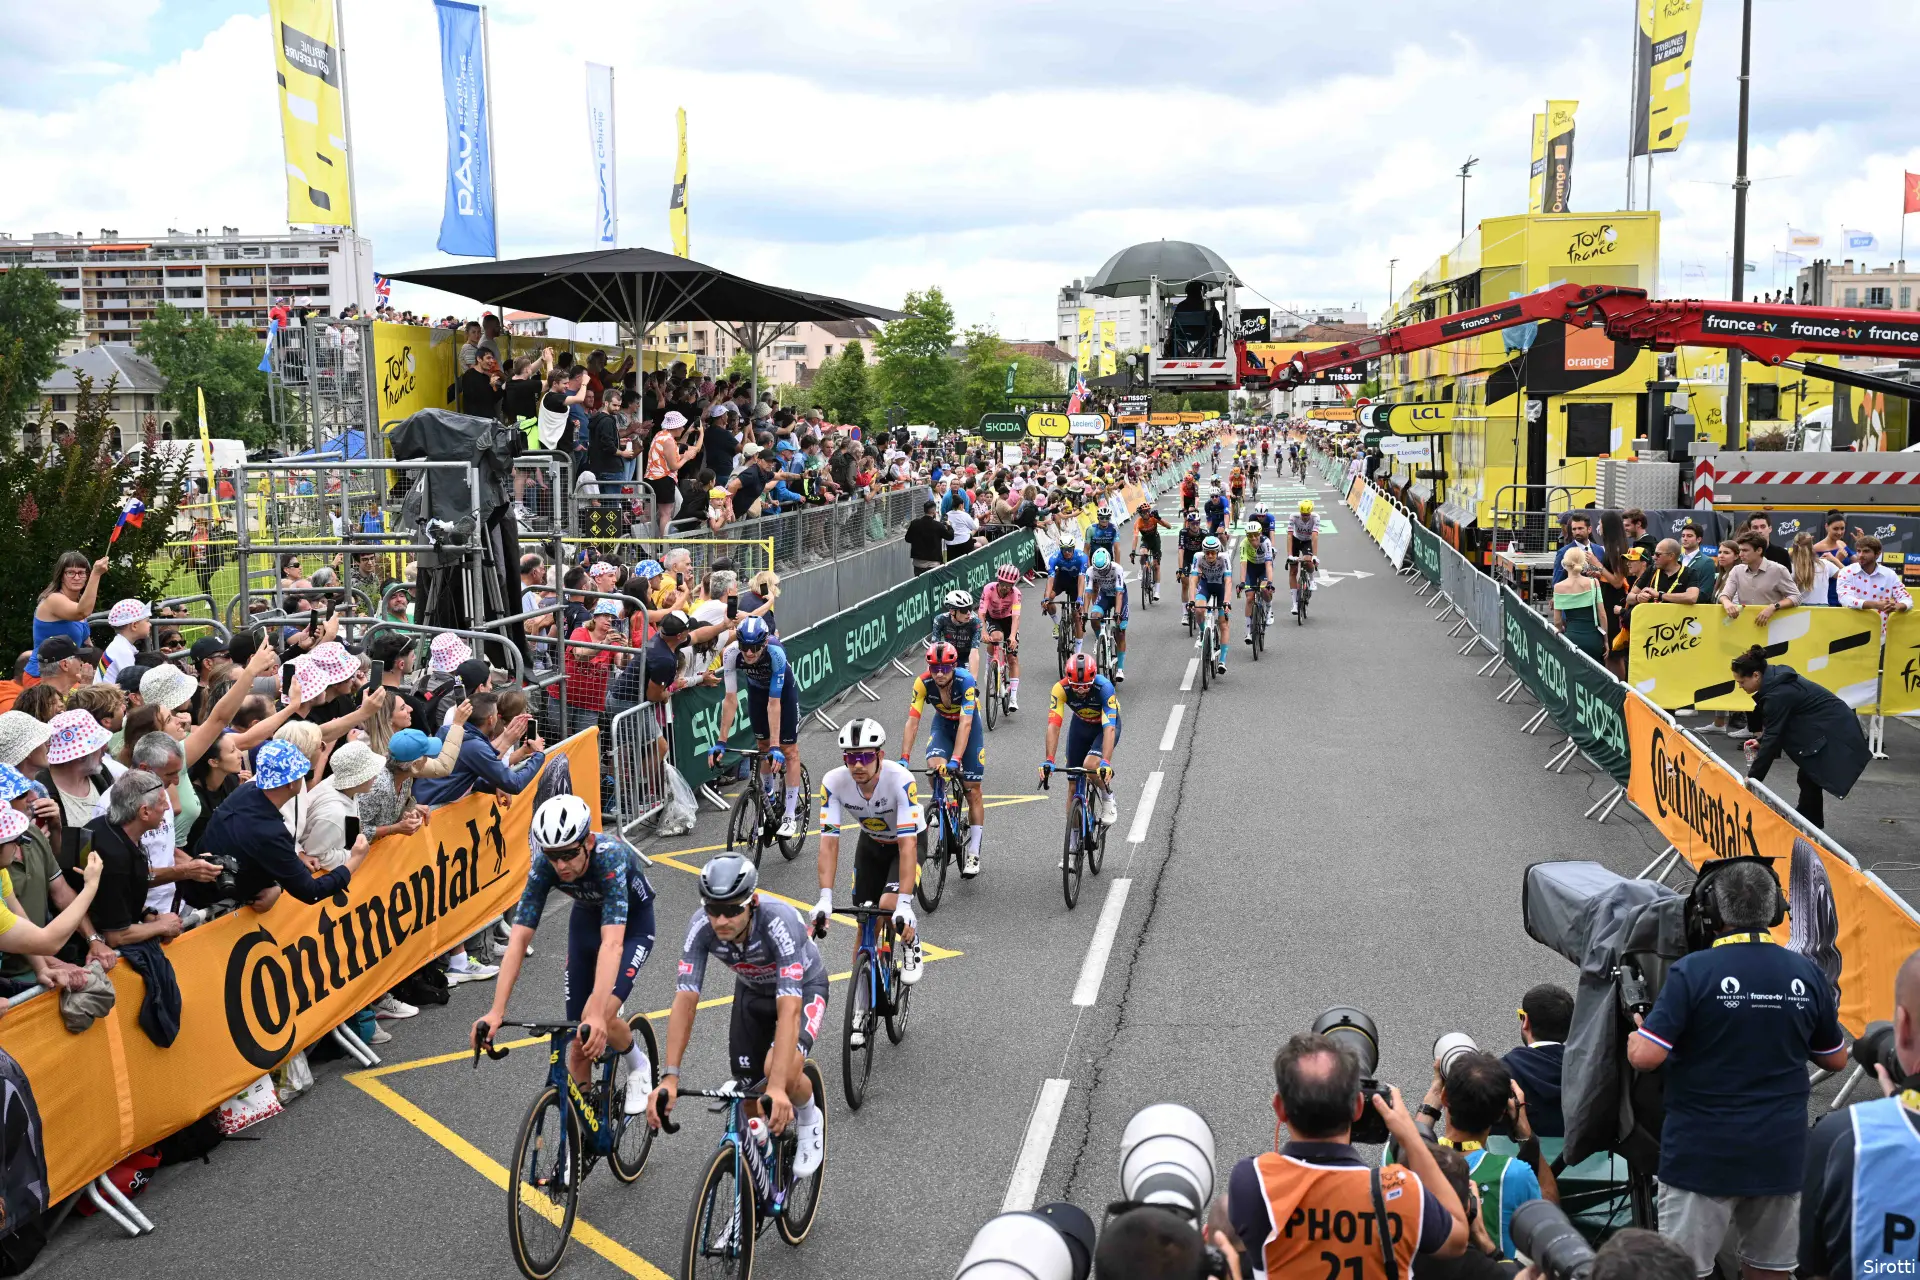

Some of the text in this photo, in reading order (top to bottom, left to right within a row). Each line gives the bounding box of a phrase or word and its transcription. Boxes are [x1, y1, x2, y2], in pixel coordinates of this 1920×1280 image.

[1654, 45, 1684, 62] TV RADIO
[1655, 35, 1685, 53] TRIBUNES
[454, 130, 475, 216] PAU
[1567, 242, 1616, 264] france
[1567, 356, 1609, 368] orange
[1328, 373, 1363, 381] TISSOT
[1040, 417, 1058, 427] LCL
[1413, 407, 1445, 420] LCL
[985, 422, 1021, 432] SKODA
[896, 593, 930, 634] SKODA
[846, 615, 887, 664] SKODA
[1648, 617, 1696, 643] TOUR
[1643, 636, 1702, 661] france
[792, 643, 832, 692] KODA
[1536, 641, 1569, 707] SKODA
[1575, 681, 1627, 759] SKODA
[224, 817, 480, 1071] Continental
[768, 916, 796, 956] Alpecin
[631, 944, 646, 969] VISMA
[567, 1073, 599, 1133] cervélo
[1285, 1207, 1403, 1246] PHOTO
